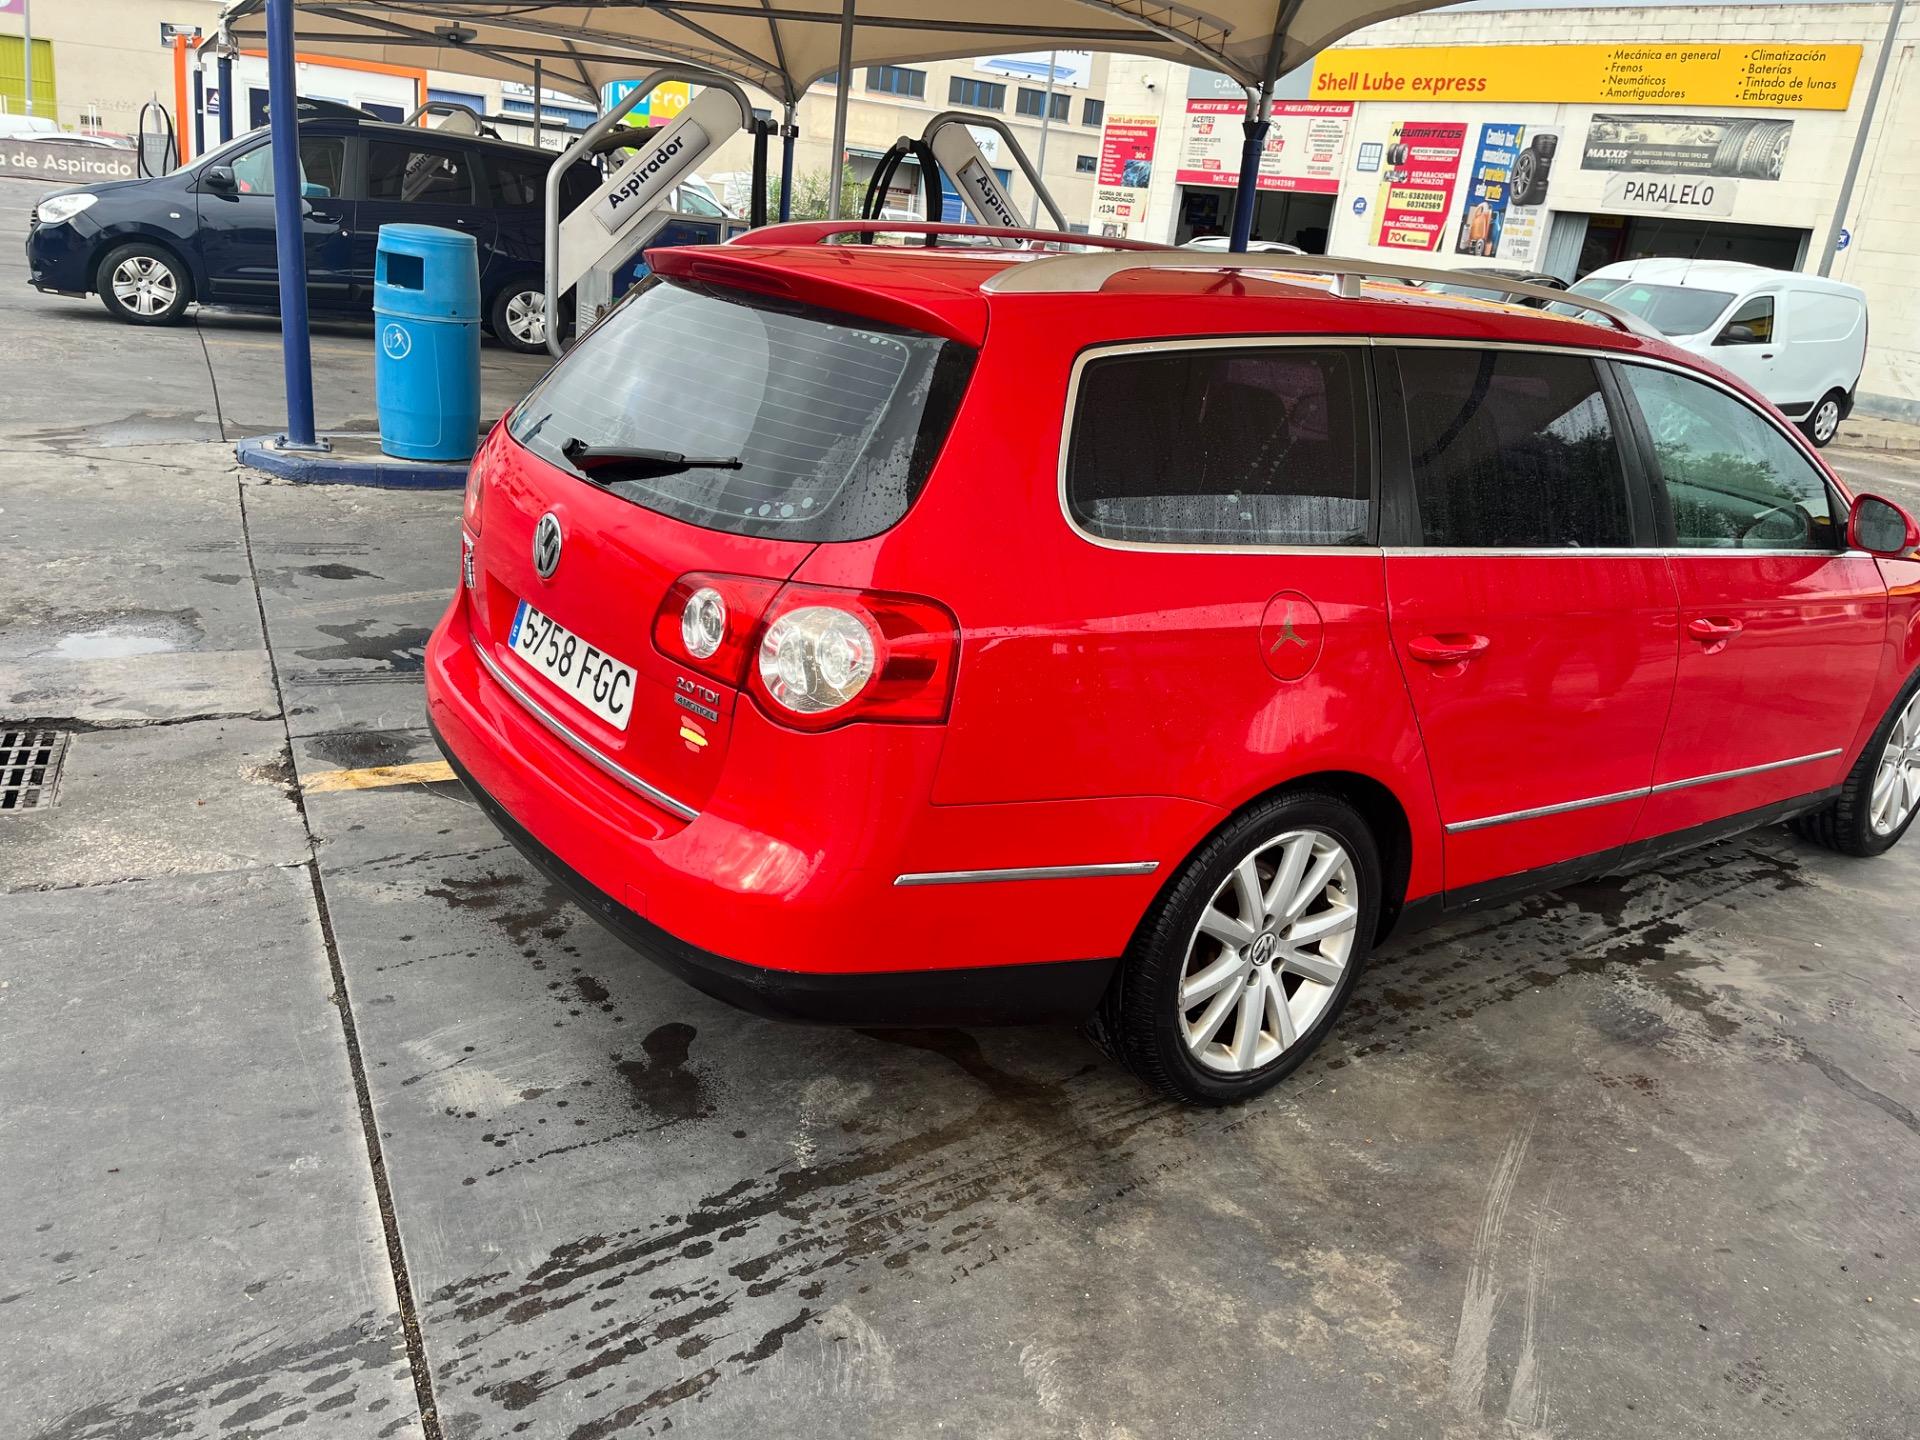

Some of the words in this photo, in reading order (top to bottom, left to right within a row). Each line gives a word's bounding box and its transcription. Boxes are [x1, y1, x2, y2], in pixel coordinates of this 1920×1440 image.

[1613, 49, 1664, 60] Mecánica
[1665, 52, 1678, 60] en
[1680, 49, 1721, 63] general
[1751, 49, 1826, 61] Climatización
[1611, 63, 1643, 73] Frenos
[1748, 63, 1792, 75] Baterías
[1317, 72, 1359, 91] Shell
[1363, 72, 1405, 91] Lube
[1411, 77, 1487, 95] express
[1608, 75, 1666, 85] Neumáticos
[1745, 77, 1785, 89] Tintado
[1789, 77, 1803, 89] de
[1807, 79, 1837, 90] lunas
[1605, 87, 1686, 99] Amortiguadores
[1742, 90, 1803, 104] Embragues
[1191, 103, 1230, 111] ACEITES
[1284, 103, 1350, 113] NEUMÁTICOS
[1108, 116, 1122, 124] Shell
[1392, 127, 1463, 139] NEUMÁTICOS
[540, 136, 558, 146] Post
[1587, 148, 1628, 159] MAXXIS
[11, 151, 38, 168] de
[43, 154, 132, 176] Aspirado
[608, 135, 684, 209] Aspirador
[1411, 171, 1456, 180] REPARACIONES
[1410, 178, 1444, 186] PINCHAZOS
[1623, 181, 1714, 206] PARALELO
[1098, 204, 1115, 214] r134
[522, 607, 577, 677] 5758
[576, 647, 631, 715] FGC
[696, 684, 720, 706] TDI
